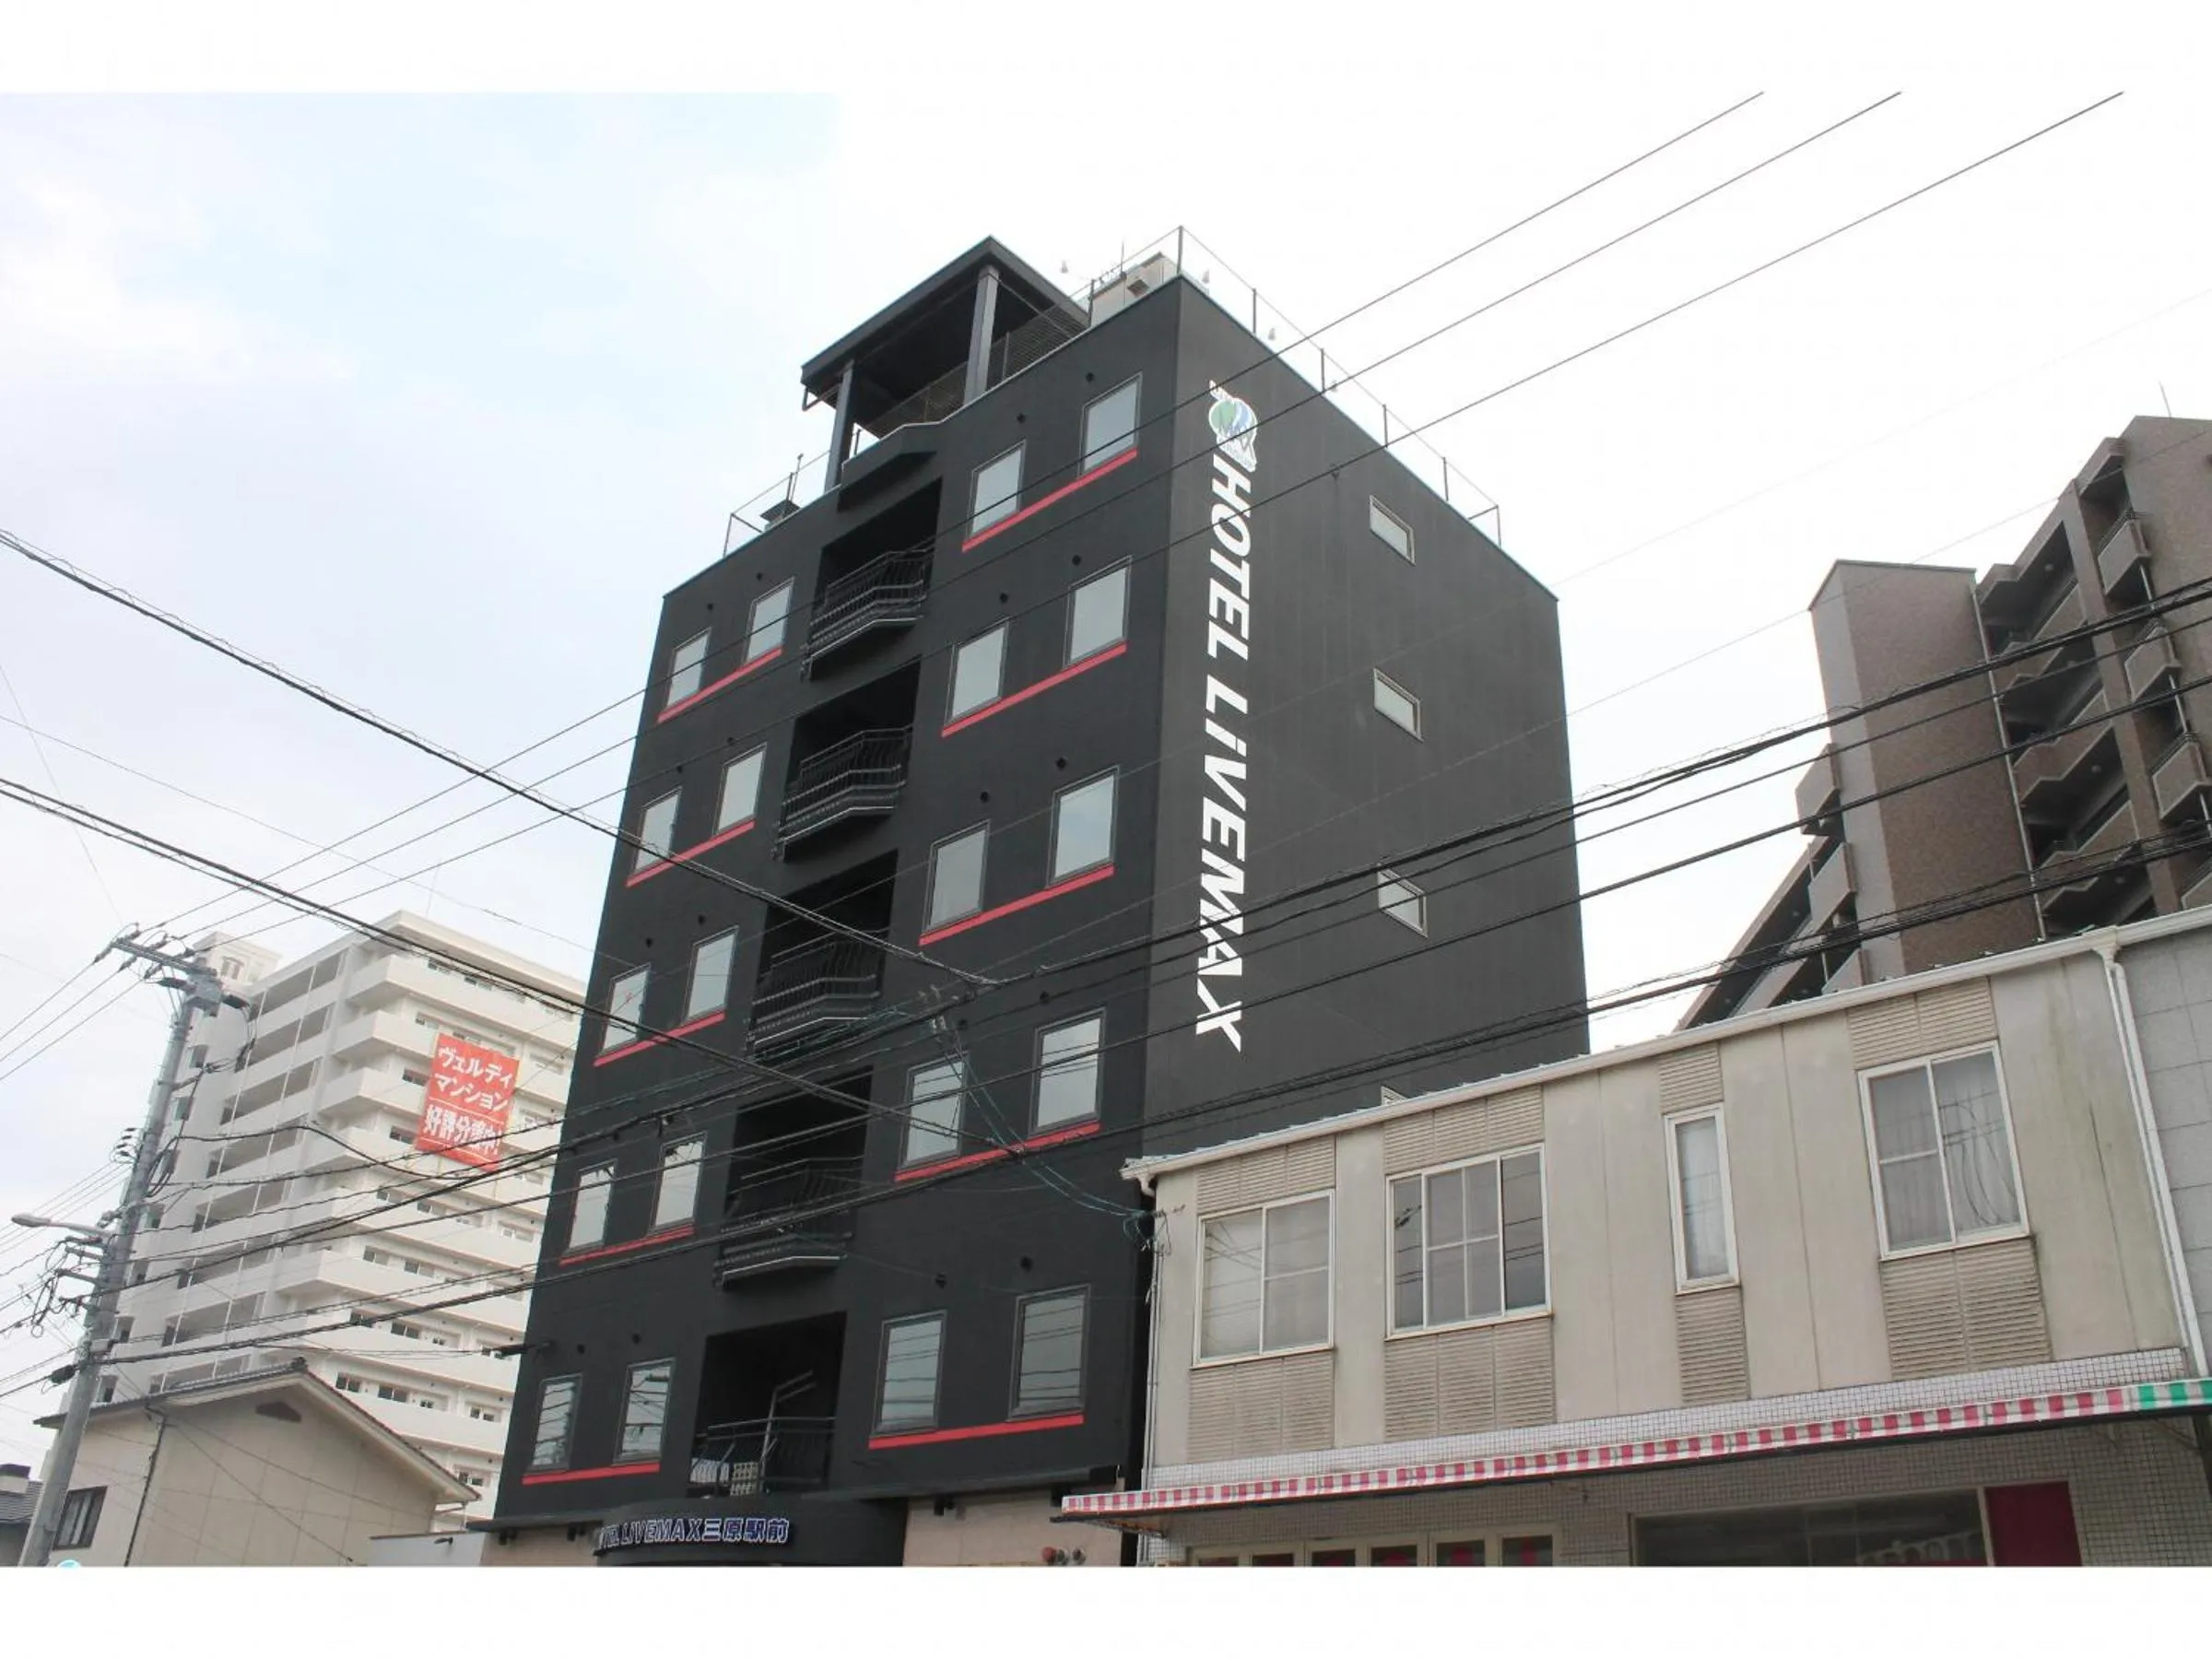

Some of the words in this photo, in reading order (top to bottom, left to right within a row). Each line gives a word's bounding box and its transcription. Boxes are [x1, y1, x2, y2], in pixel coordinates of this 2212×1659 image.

[1208, 453, 1251, 661] HOTEL
[434, 1073, 509, 1112] マンション
